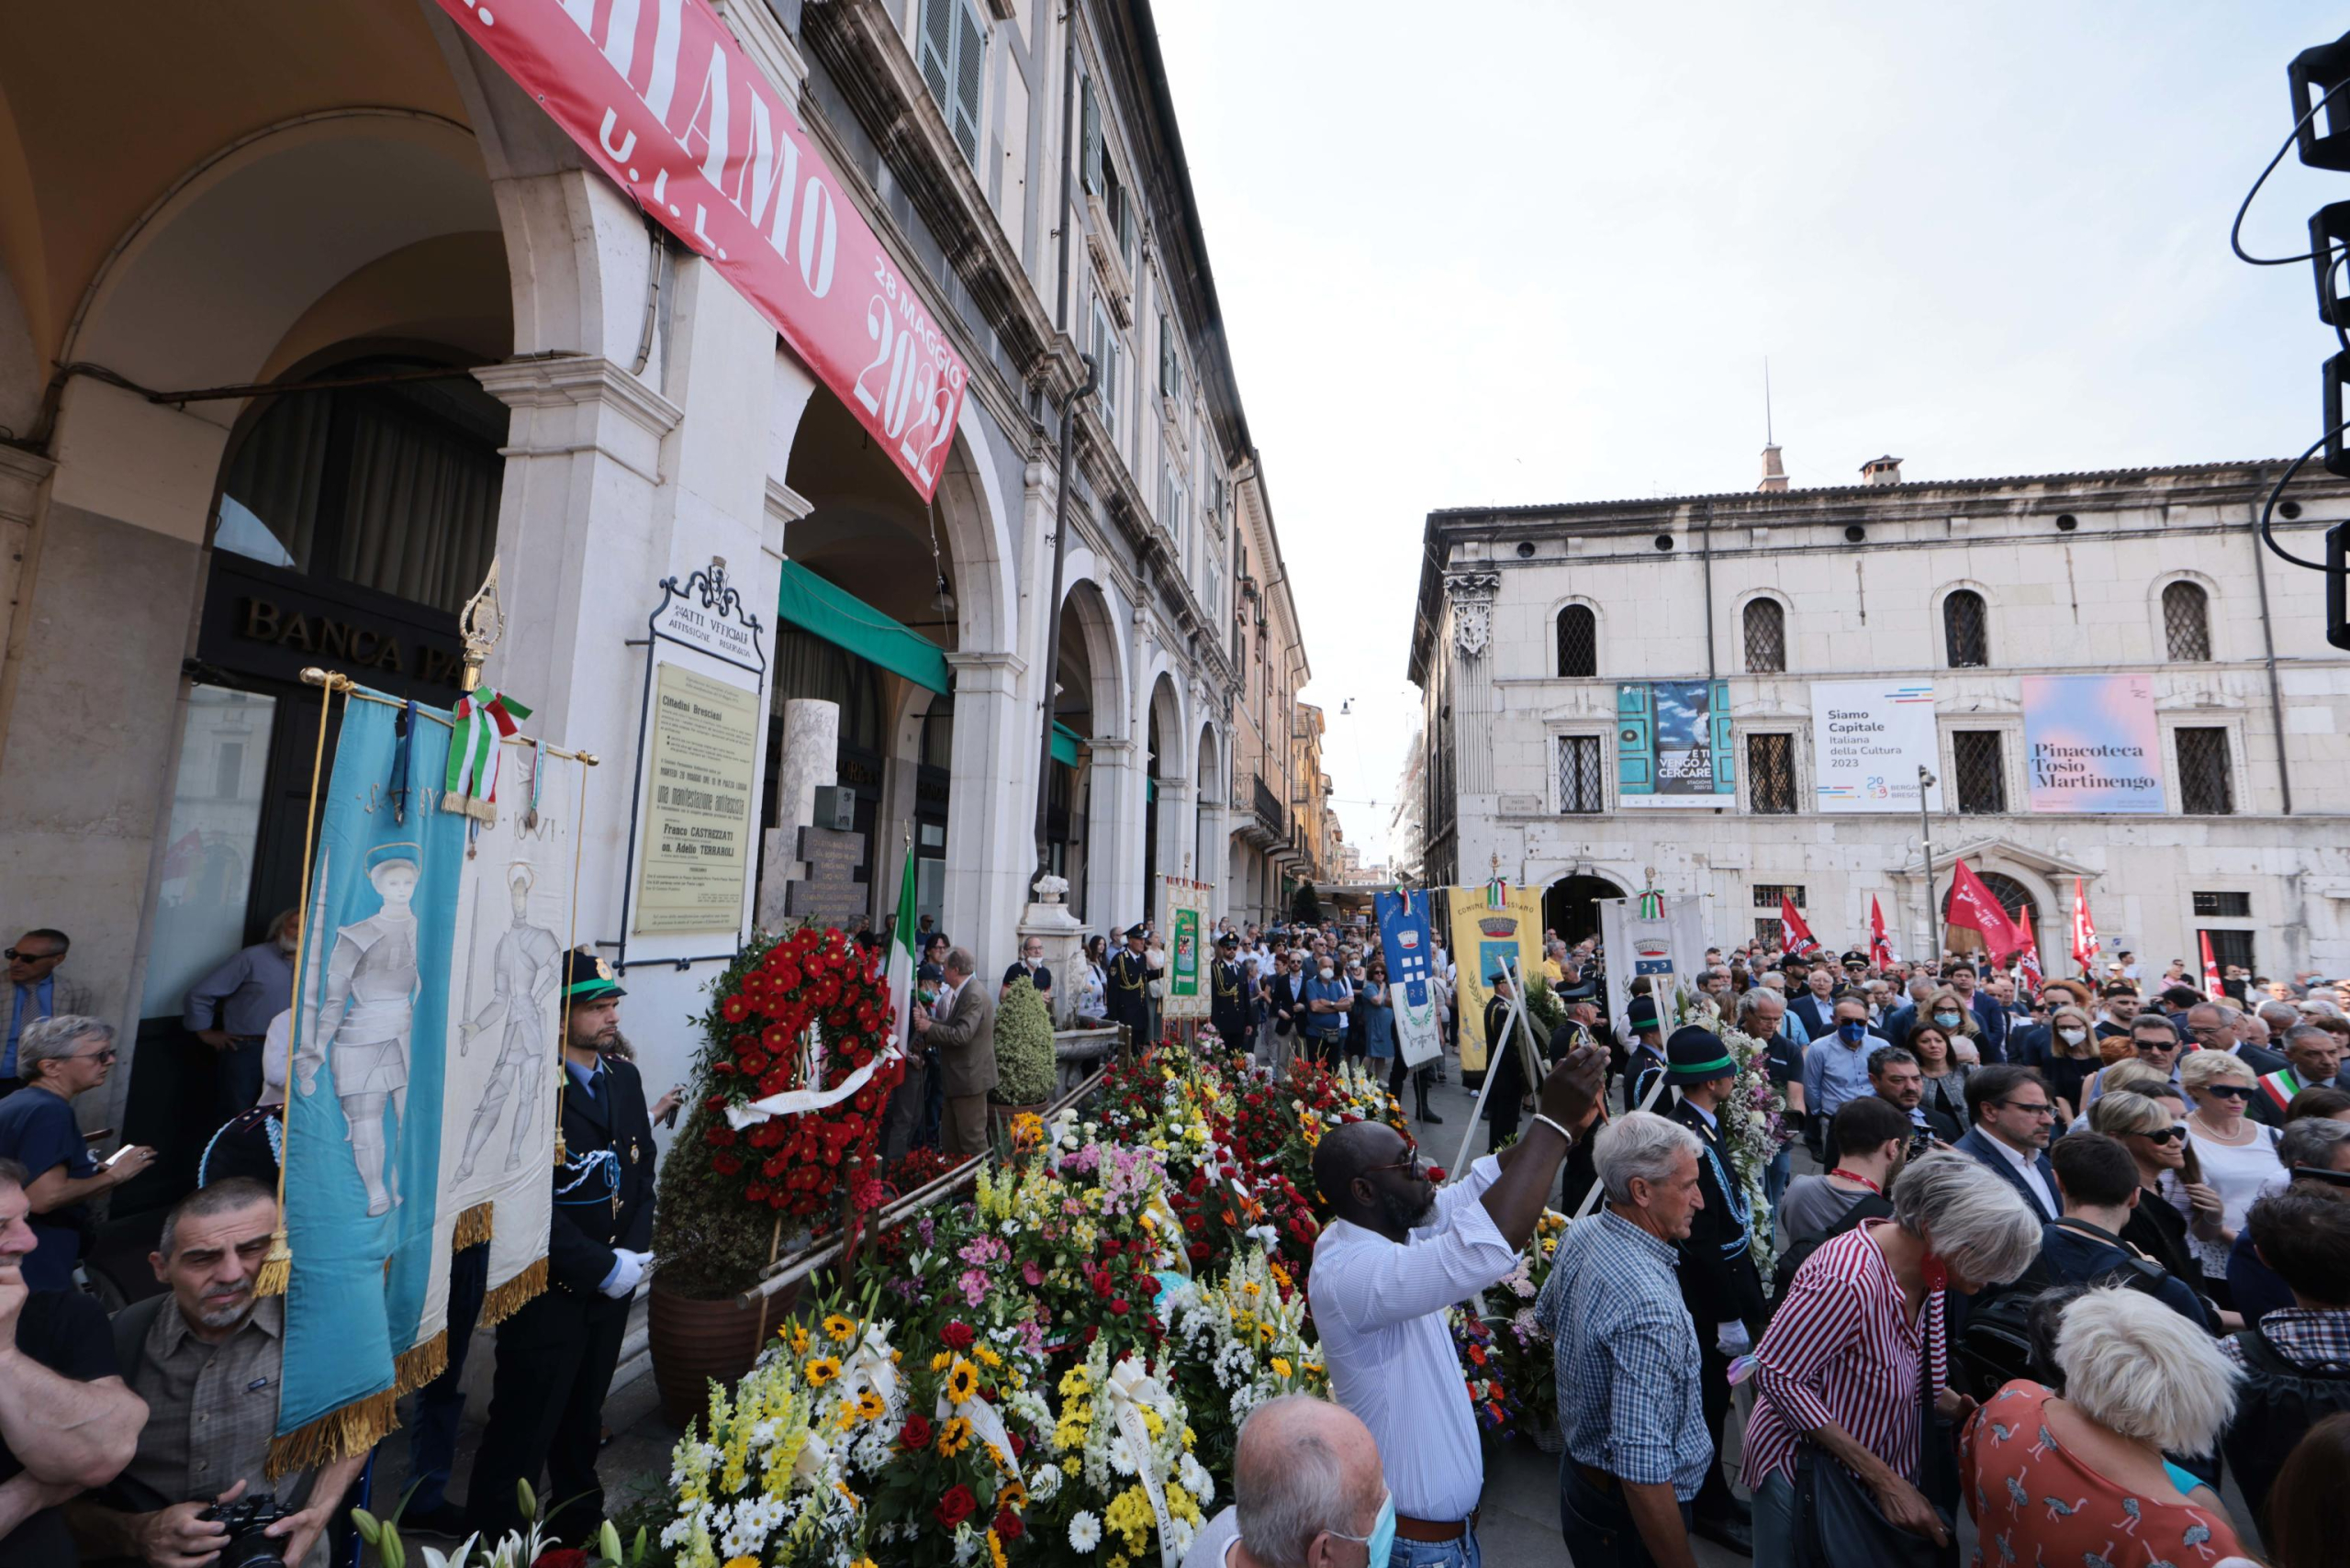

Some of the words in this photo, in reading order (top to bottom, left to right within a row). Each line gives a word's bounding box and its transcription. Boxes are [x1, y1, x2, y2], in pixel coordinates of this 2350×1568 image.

[874, 255, 897, 301] 28
[899, 293, 962, 389] MAGGIO
[854, 294, 955, 488] 2022
[245, 599, 403, 674] BANCA
[668, 619, 711, 643] AFFISSIONE
[662, 694, 690, 712] Cittadini
[693, 703, 722, 722] Bresciani
[1828, 710, 1869, 720] Siamo
[1829, 722, 1885, 734] Capitale
[1830, 735, 1870, 745] Italiana
[1692, 749, 1699, 758] E
[1702, 749, 1710, 757] TI
[1830, 747, 1857, 756] della
[1860, 745, 1902, 756] Cultura
[2033, 743, 2143, 757] Pinacoteca
[1660, 758, 1700, 767] VENGO
[1702, 759, 1712, 767] A
[1831, 758, 1859, 767] 2023
[2031, 758, 2085, 773] Tosio
[1659, 767, 1712, 778] CERCARE
[2036, 774, 2155, 791] Martinengo
[671, 787, 713, 811] manifestazione
[715, 793, 744, 815] antifascista
[664, 823, 688, 836] Franco
[690, 826, 733, 842] CASTREZZATI
[661, 844, 672, 853] on.
[676, 843, 697, 854] Adelio
